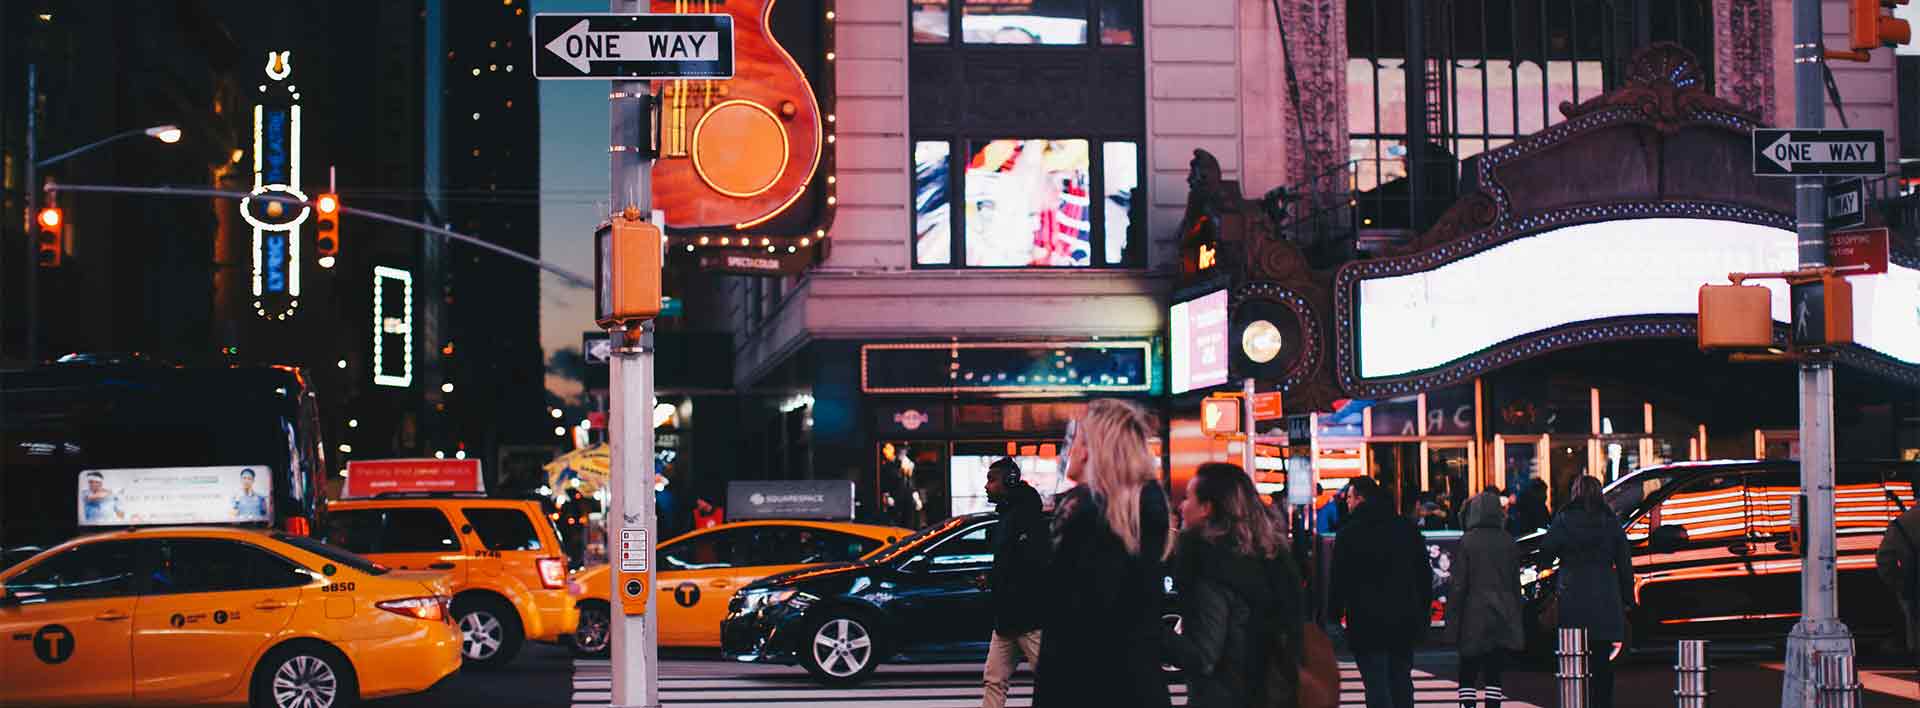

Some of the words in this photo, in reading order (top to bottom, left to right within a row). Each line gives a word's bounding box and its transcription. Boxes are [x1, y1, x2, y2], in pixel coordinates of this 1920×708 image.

[566, 34, 621, 59] ONE
[648, 34, 707, 58] WAY
[1774, 143, 1812, 161] ONE
[1829, 143, 1869, 161] WAY
[266, 234, 285, 291] LYRIC
[680, 585, 695, 605] T
[43, 631, 65, 658] T
